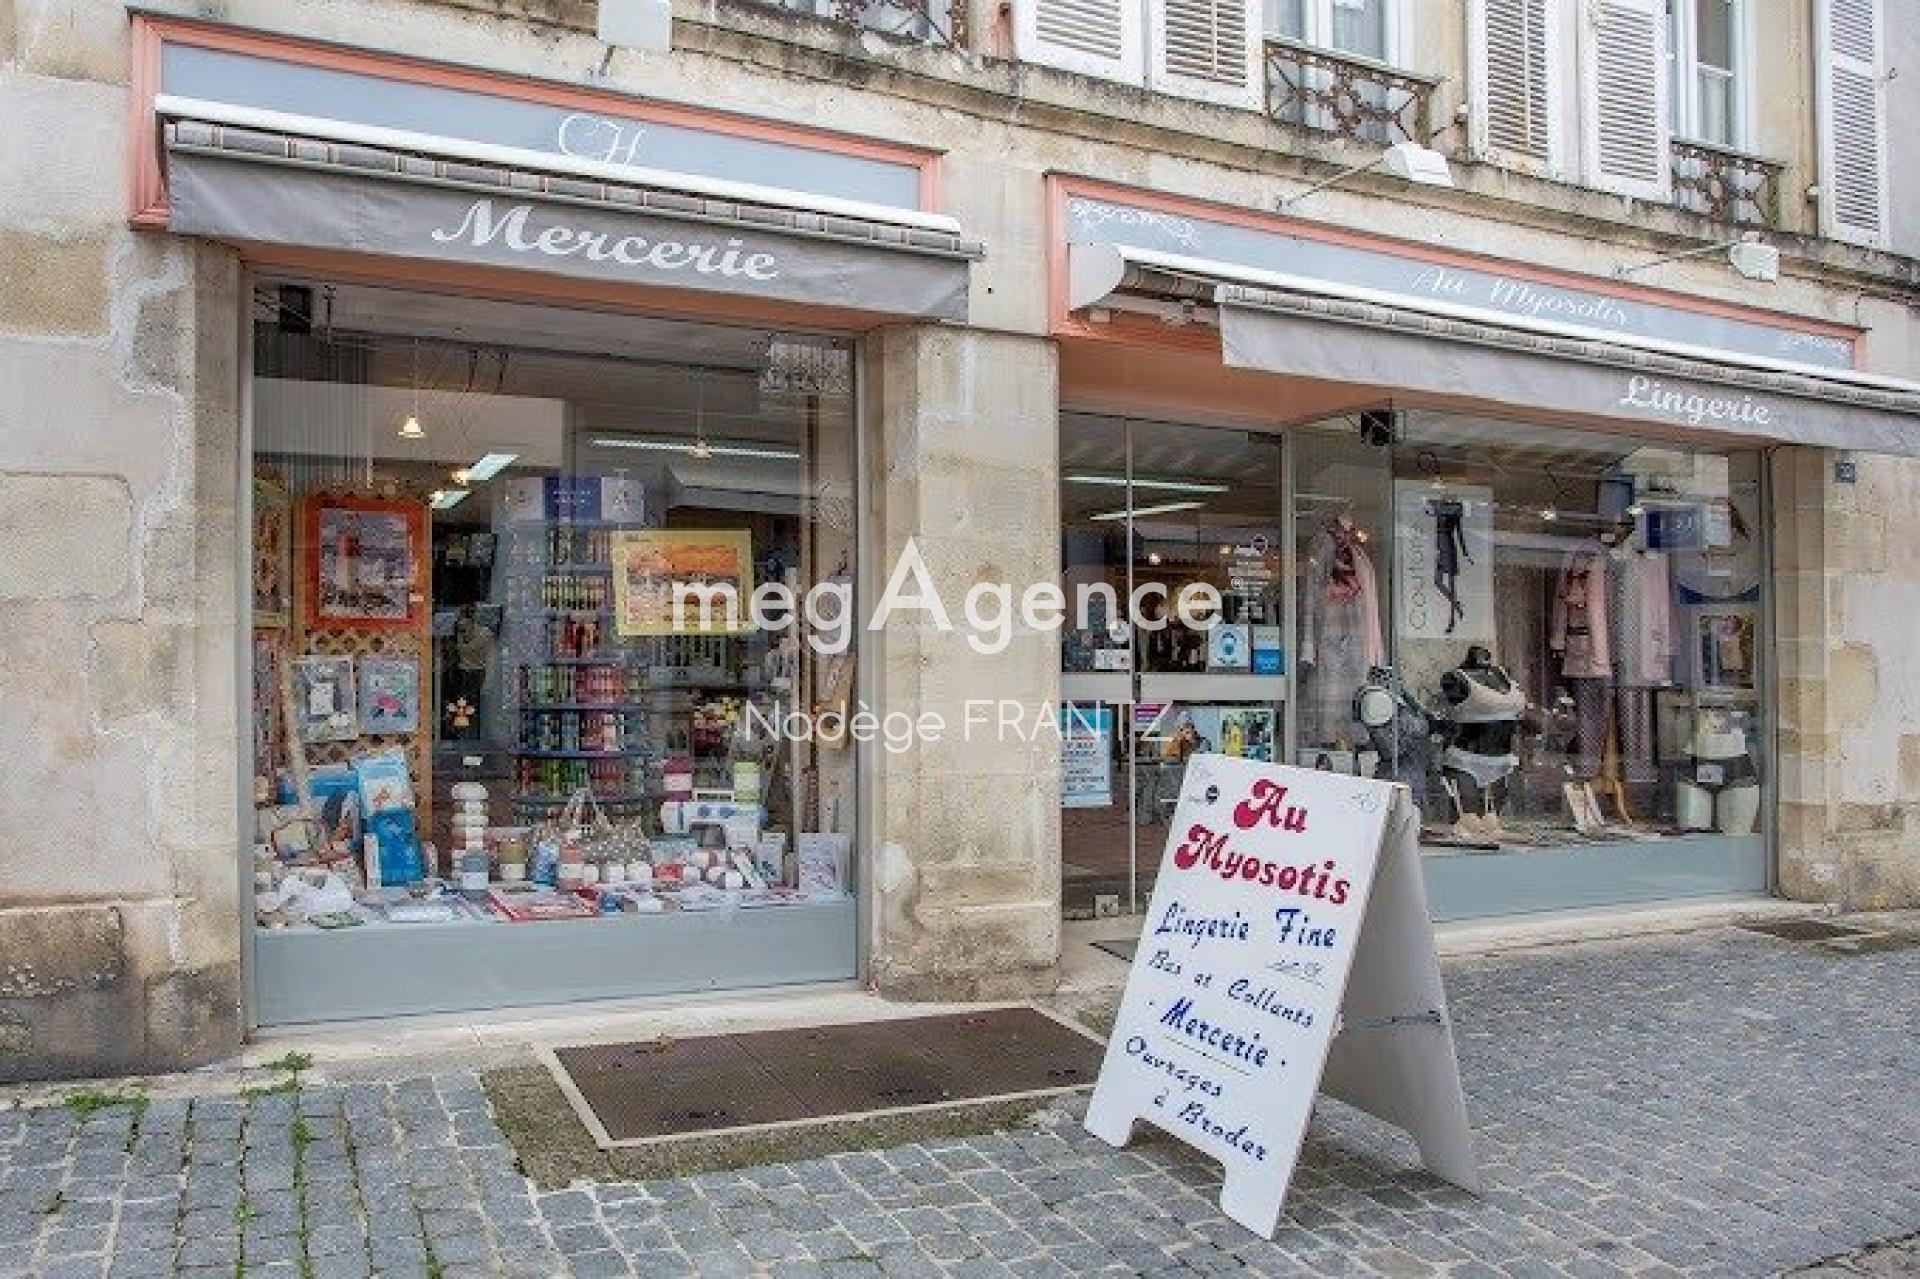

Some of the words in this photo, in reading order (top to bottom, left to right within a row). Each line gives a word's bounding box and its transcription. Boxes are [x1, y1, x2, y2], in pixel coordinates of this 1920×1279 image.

[431, 199, 780, 282] Mercerie
[1404, 265, 1468, 295] Au
[1489, 278, 1627, 327] Myosotis
[1620, 375, 1772, 425] Lingerie
[1233, 778, 1308, 834] Au
[1174, 823, 1351, 905] Myosotis
[1155, 901, 1249, 949] Lingerie
[1275, 908, 1337, 948] Fine
[1148, 949, 1182, 975] Bas
[1227, 978, 1314, 1028] Collants
[1160, 996, 1269, 1068] Mercerie
[1126, 1035, 1223, 1097] Ouvrages
[1177, 1100, 1267, 1162] Broder
